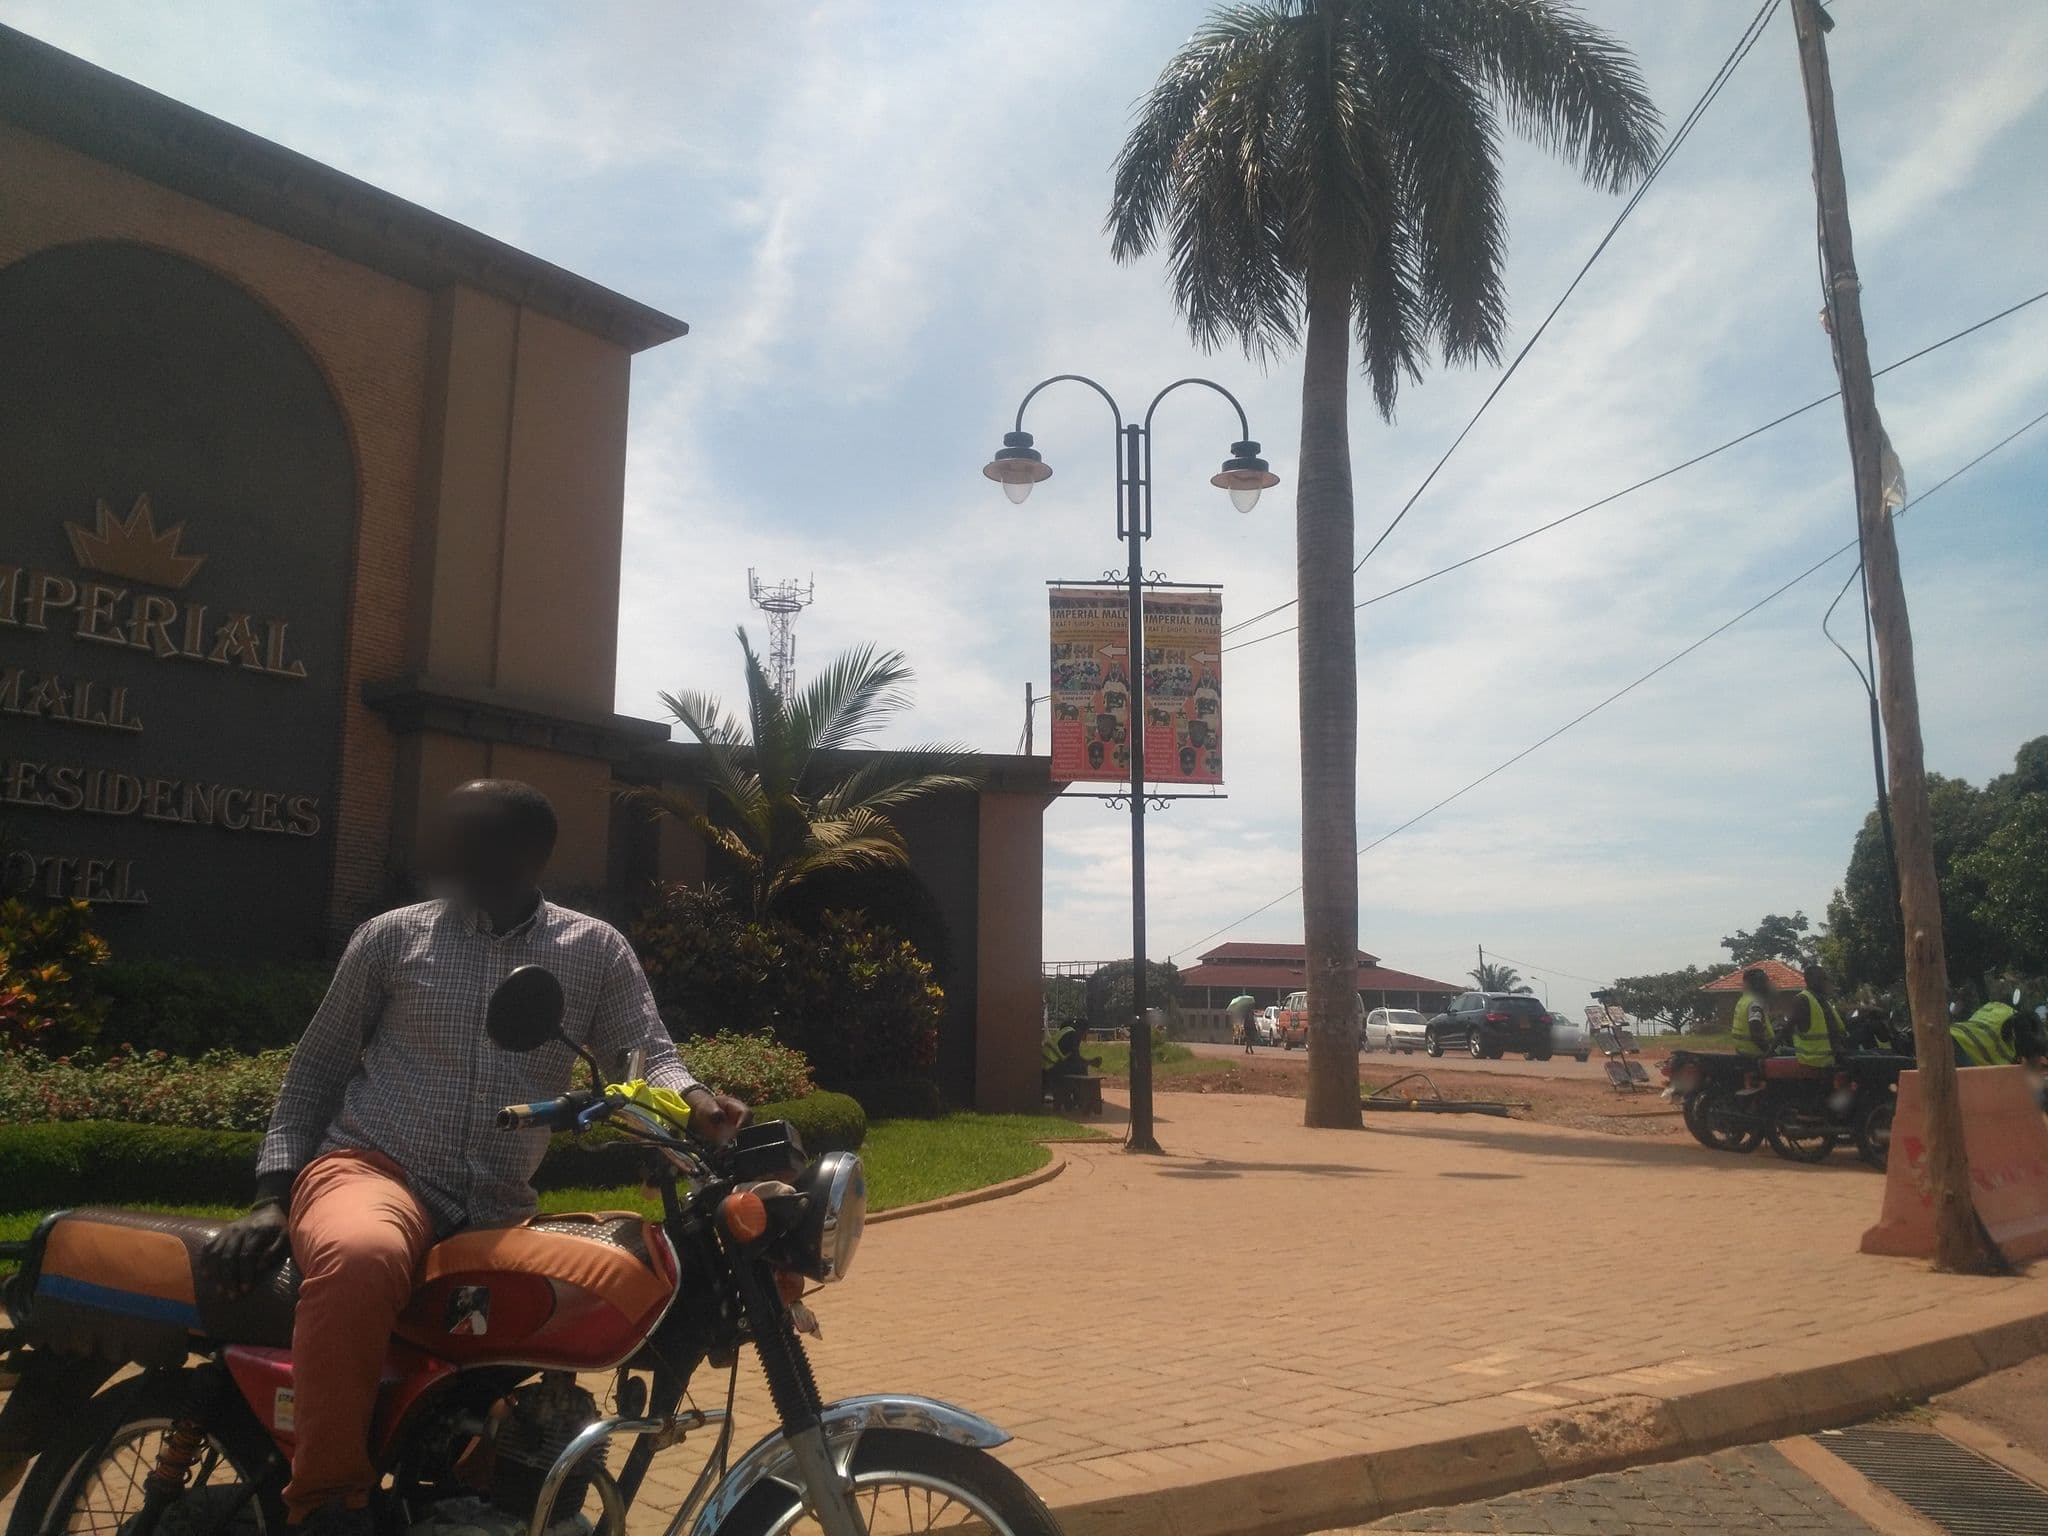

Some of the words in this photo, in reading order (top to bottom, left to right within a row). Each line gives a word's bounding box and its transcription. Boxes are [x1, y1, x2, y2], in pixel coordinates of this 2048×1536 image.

[1052, 609, 1099, 619] IMPERIAL
[1102, 609, 1128, 619] MALL
[1145, 614, 1192, 625] IMPERIAL
[1195, 616, 1220, 626] MALL
